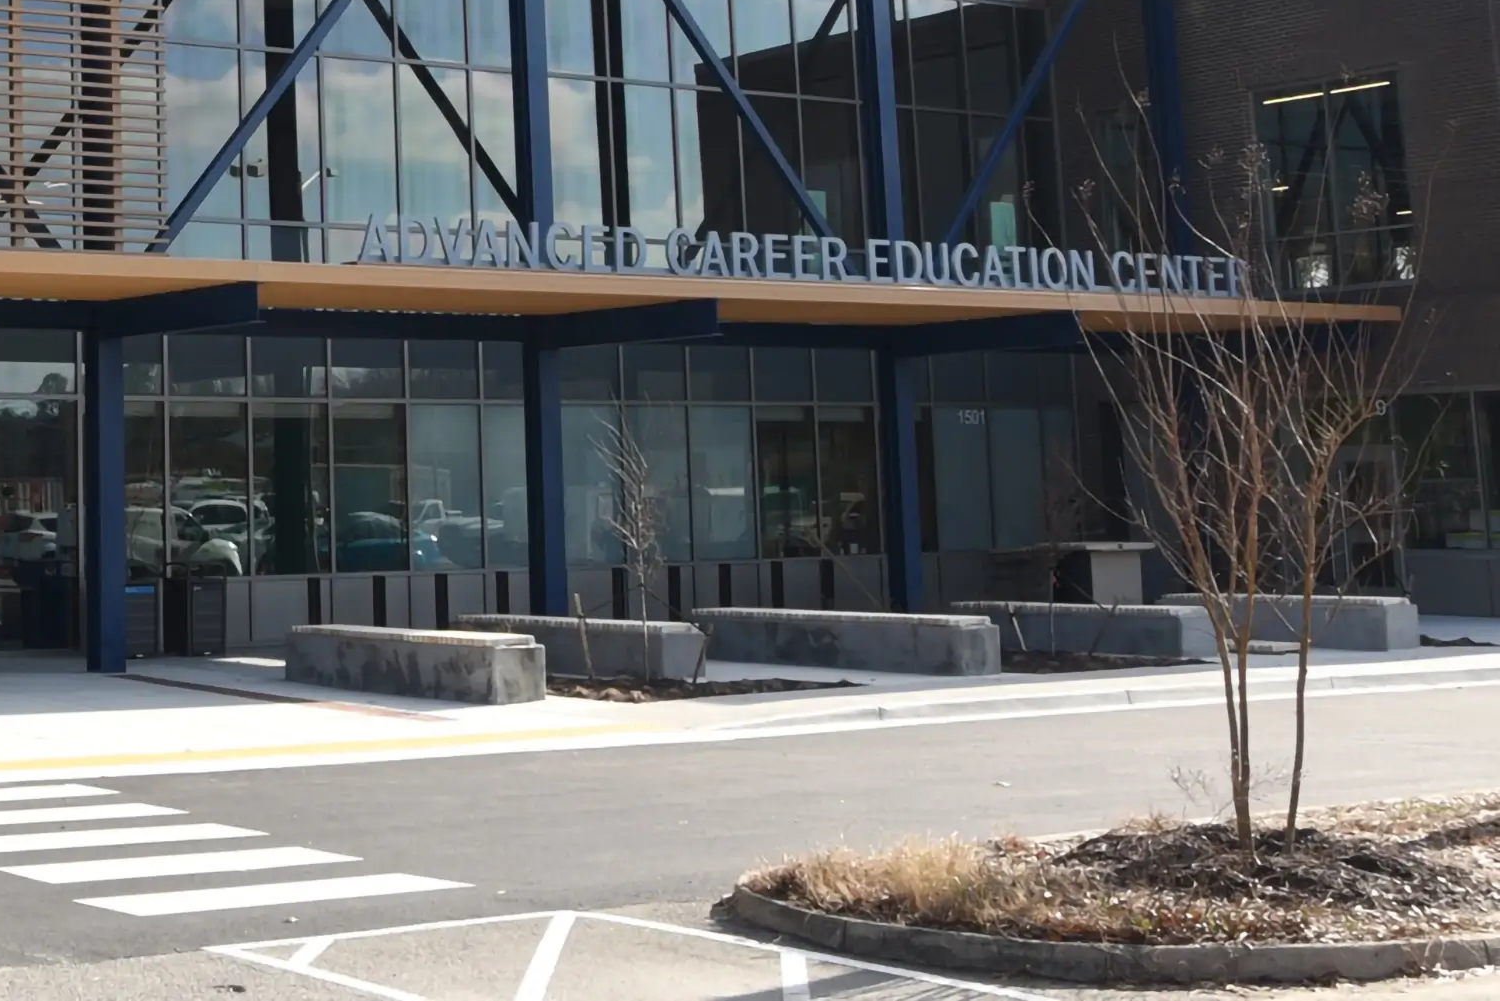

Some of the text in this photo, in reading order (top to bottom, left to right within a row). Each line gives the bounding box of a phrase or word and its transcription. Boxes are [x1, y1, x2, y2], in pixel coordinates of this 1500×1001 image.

[358, 213, 648, 274] ADVANCED
[666, 227, 850, 282] CAREER
[867, 238, 1096, 291] EDUCATION
[956, 408, 985, 426] 1501
